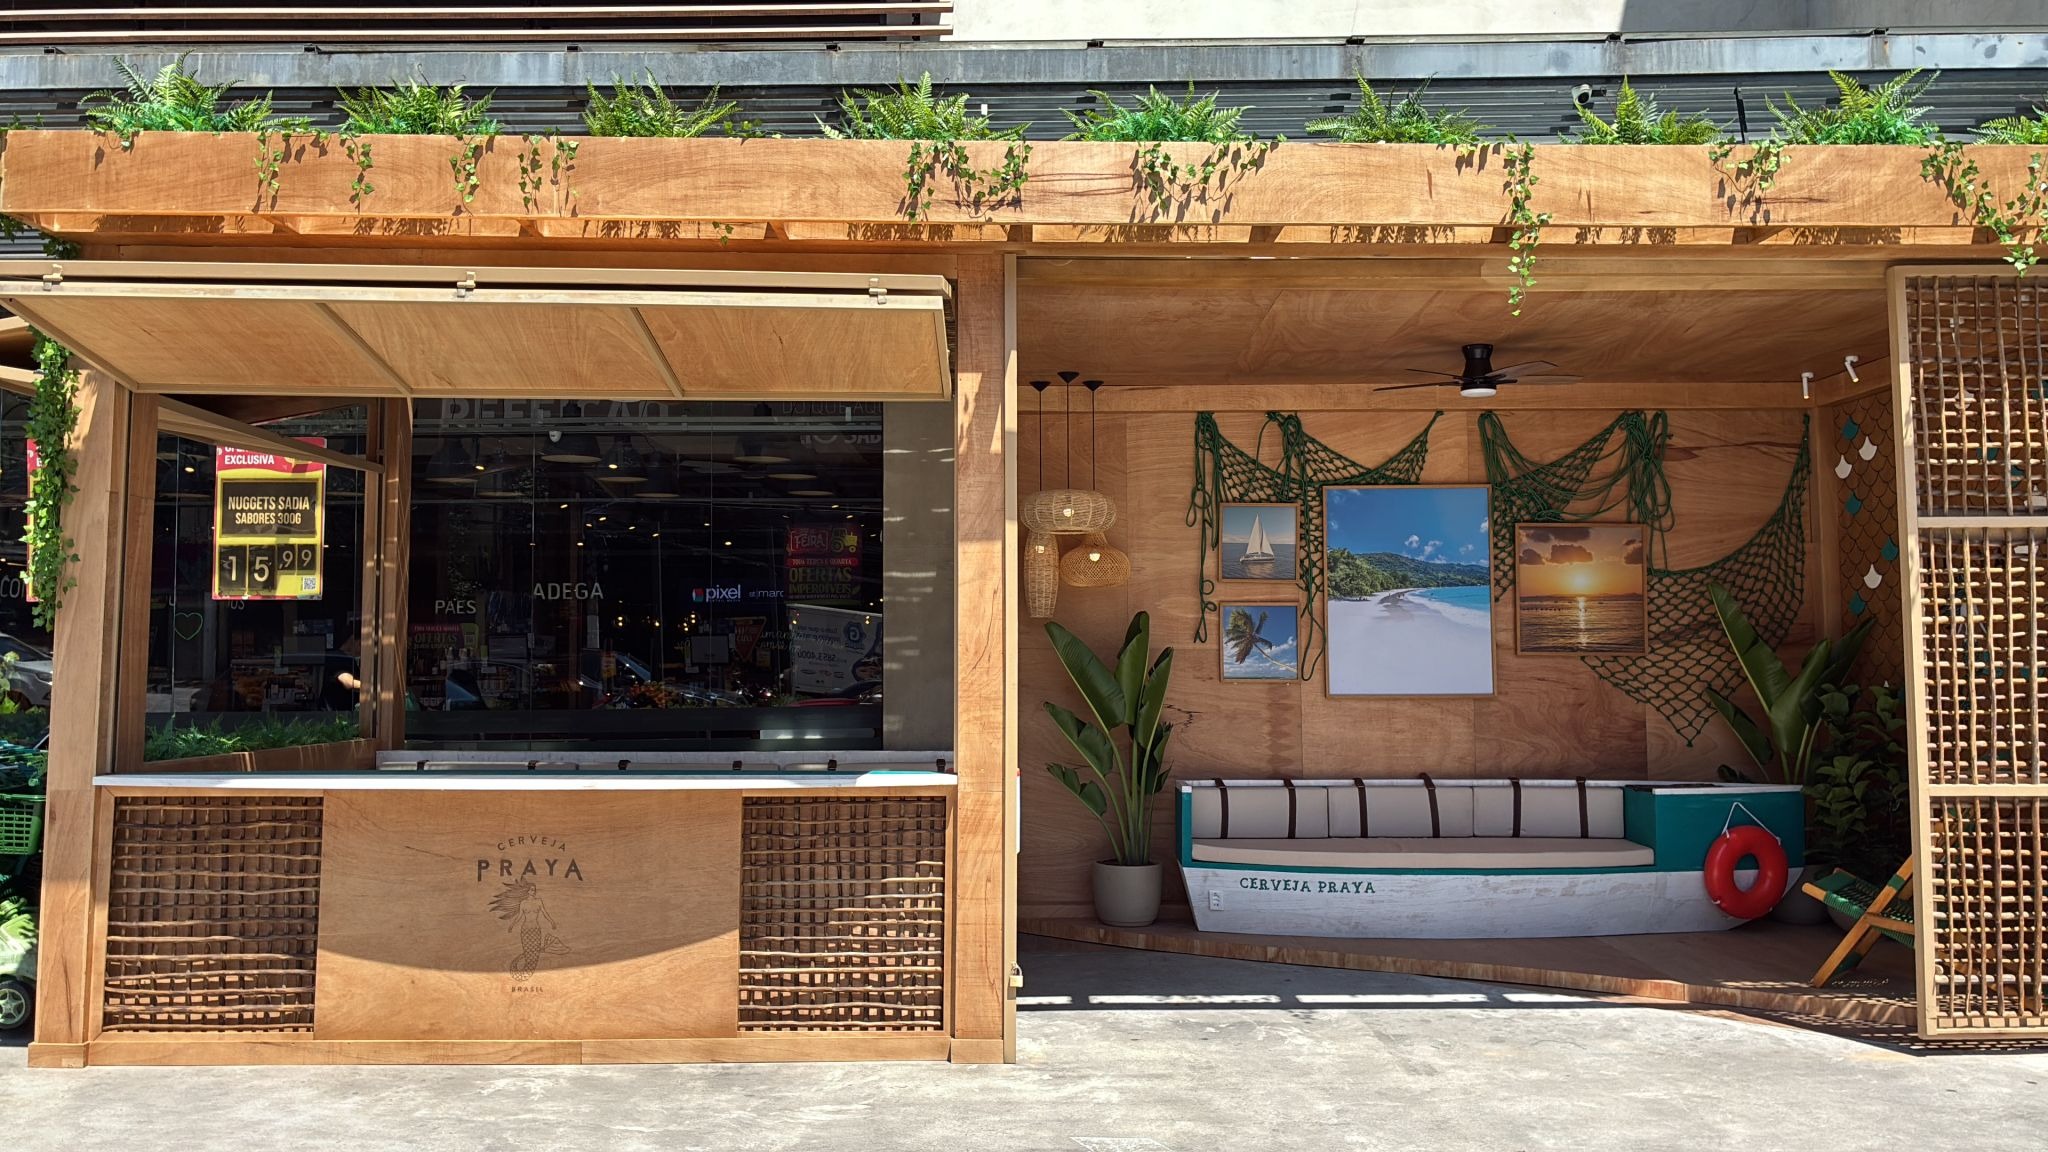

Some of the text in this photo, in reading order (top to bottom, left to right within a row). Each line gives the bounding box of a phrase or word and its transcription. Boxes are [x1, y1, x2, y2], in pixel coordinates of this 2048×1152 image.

[224, 454, 275, 465] EXCLUSIVA
[228, 496, 310, 511] NUGGETS SADIA
[235, 512, 302, 525] SABORES 300G
[533, 582, 604, 600] ADEGA
[705, 584, 741, 602] pixel
[497, 835, 566, 852] CERVEJA
[477, 858, 583, 882] PRAYA
[1240, 877, 1377, 895] CERVEJA PRAYA
